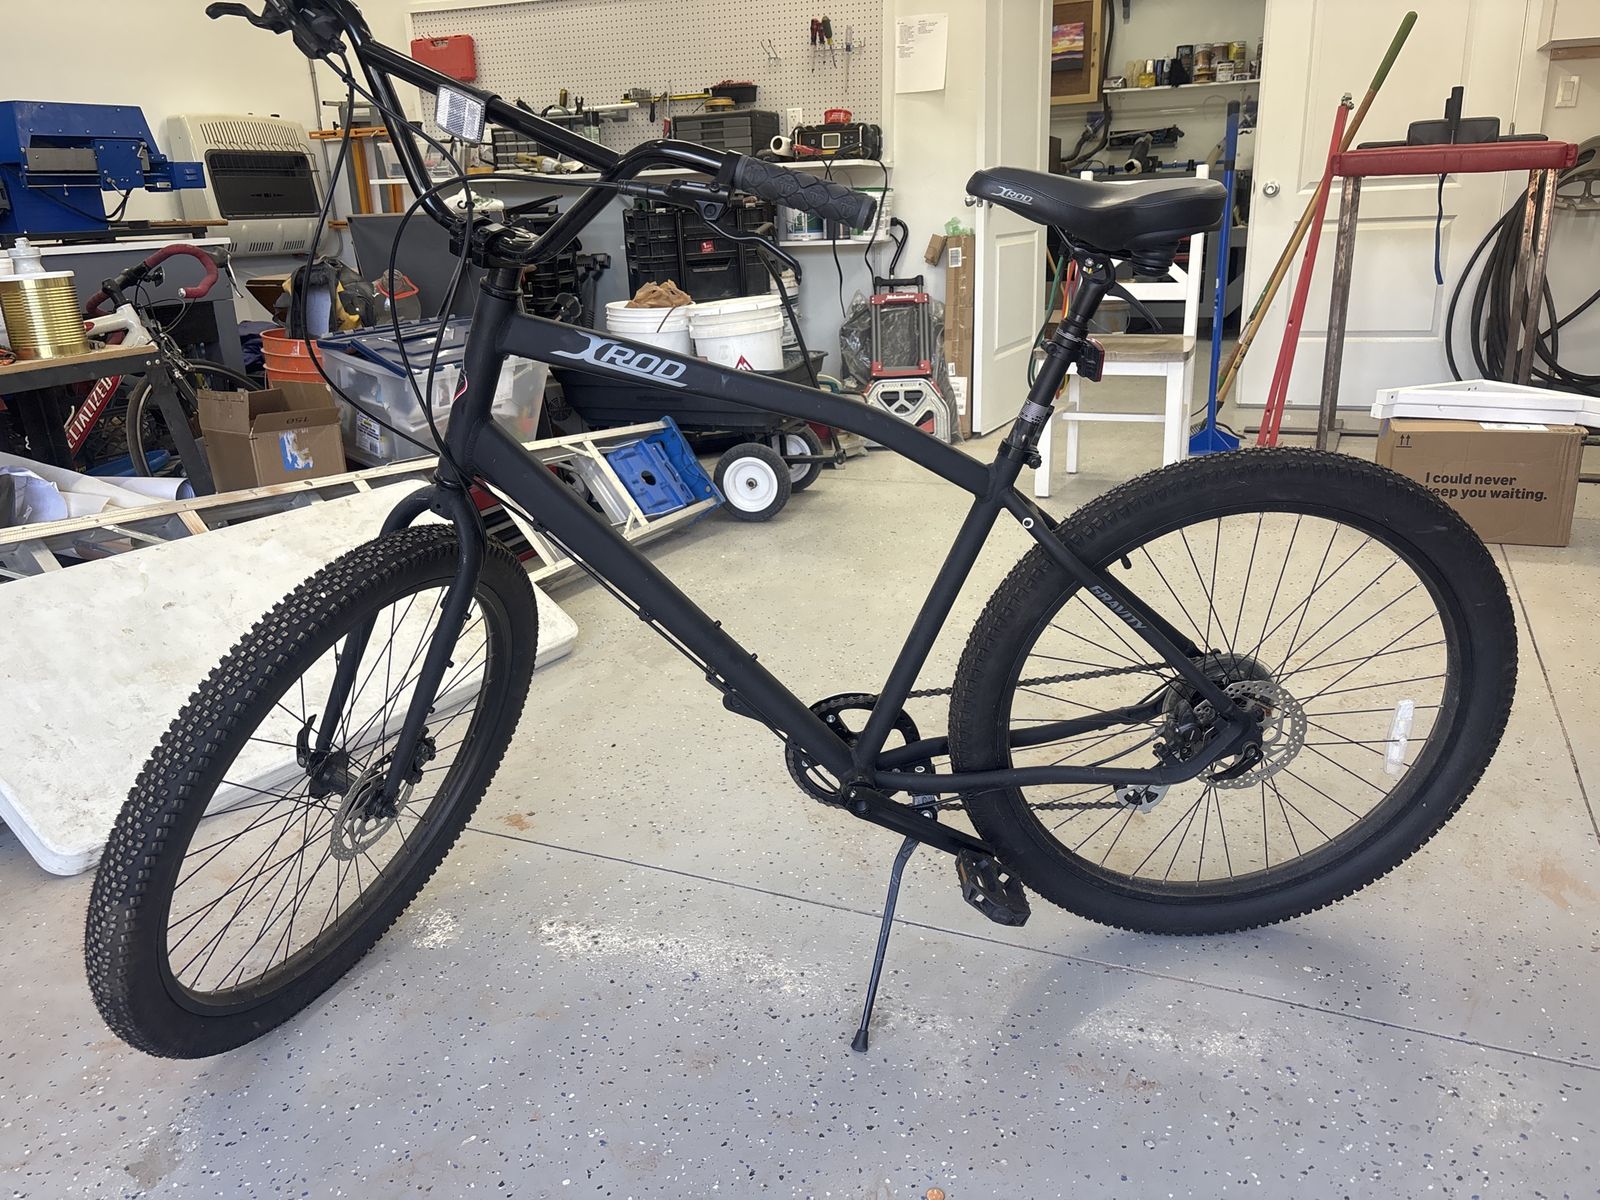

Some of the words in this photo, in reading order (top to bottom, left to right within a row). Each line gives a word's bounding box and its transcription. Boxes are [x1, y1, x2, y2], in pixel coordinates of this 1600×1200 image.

[991, 185, 1033, 206] XROD
[550, 329, 687, 387] XROD
[67, 376, 114, 449] ECIALIZED
[1425, 472, 1430, 483] I
[1432, 473, 1472, 485] could
[1474, 476, 1517, 486] never
[1460, 488, 1487, 500] you
[1490, 488, 1548, 502] waiting.
[1090, 585, 1147, 629] GRAVITY
